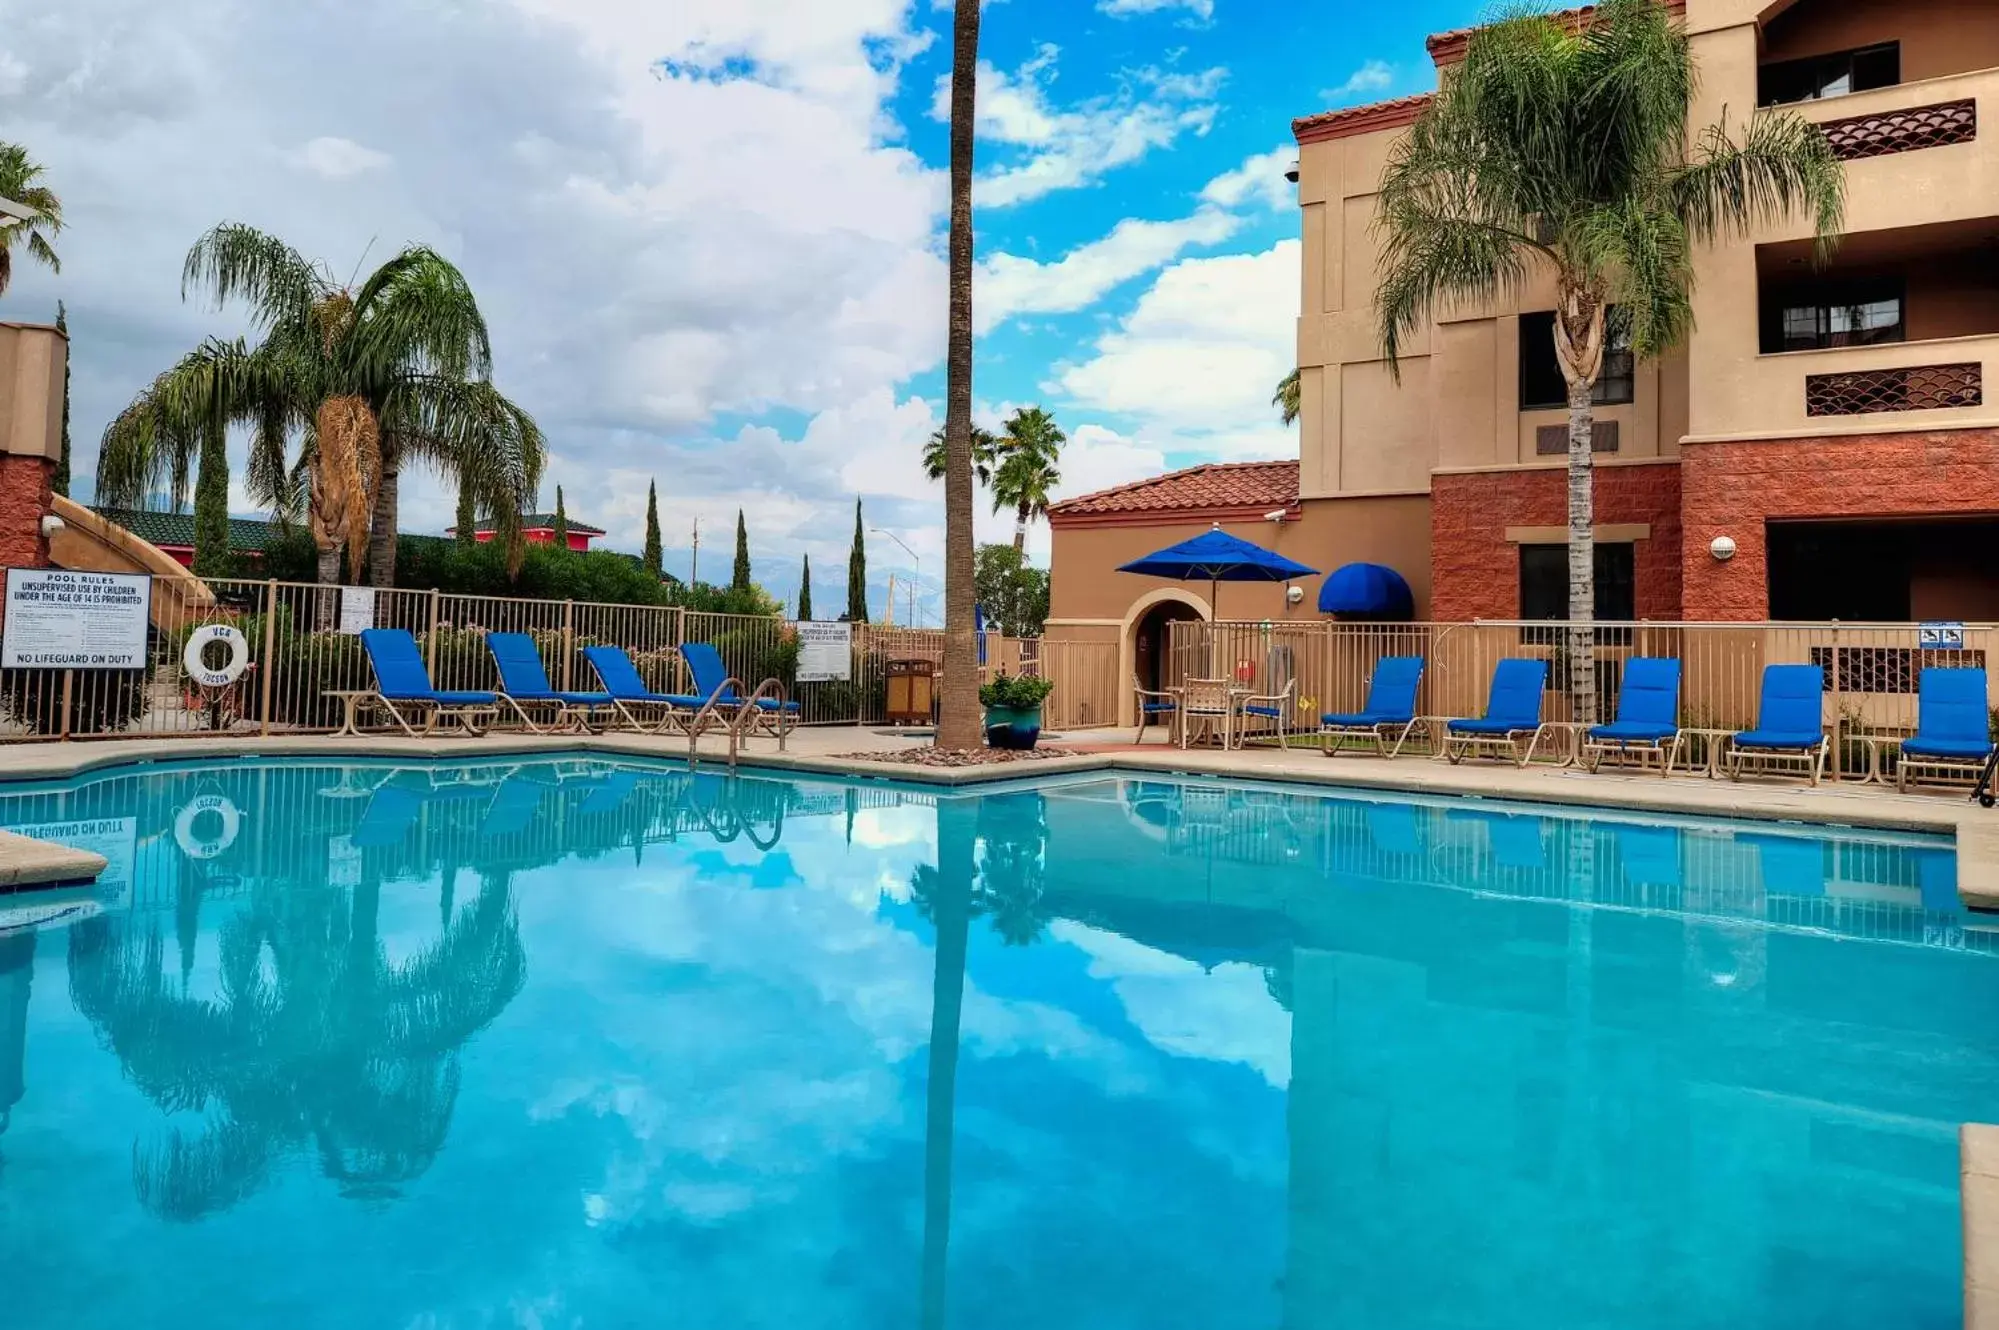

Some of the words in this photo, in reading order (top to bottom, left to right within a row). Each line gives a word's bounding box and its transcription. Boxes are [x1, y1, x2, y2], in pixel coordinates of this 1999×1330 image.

[47, 574, 76, 582] POOL
[81, 575, 114, 584] RULES
[22, 582, 76, 593] UNSUPERVISED
[78, 584, 91, 593] USE
[93, 585, 102, 594] BY
[103, 586, 136, 595] CHILDREN
[14, 592, 39, 600] UNDER
[42, 592, 55, 601] THE
[57, 593, 71, 602] AGE
[73, 594, 82, 603] OF
[84, 594, 92, 603] 14
[93, 595, 101, 603] IS
[102, 595, 142, 605] PROHIBITED
[17, 654, 32, 663] NO
[35, 654, 89, 664] LIFEGUARD
[91, 655, 105, 664] ON
[108, 655, 133, 664] DUTY
[203, 673, 229, 683] TUCSON
